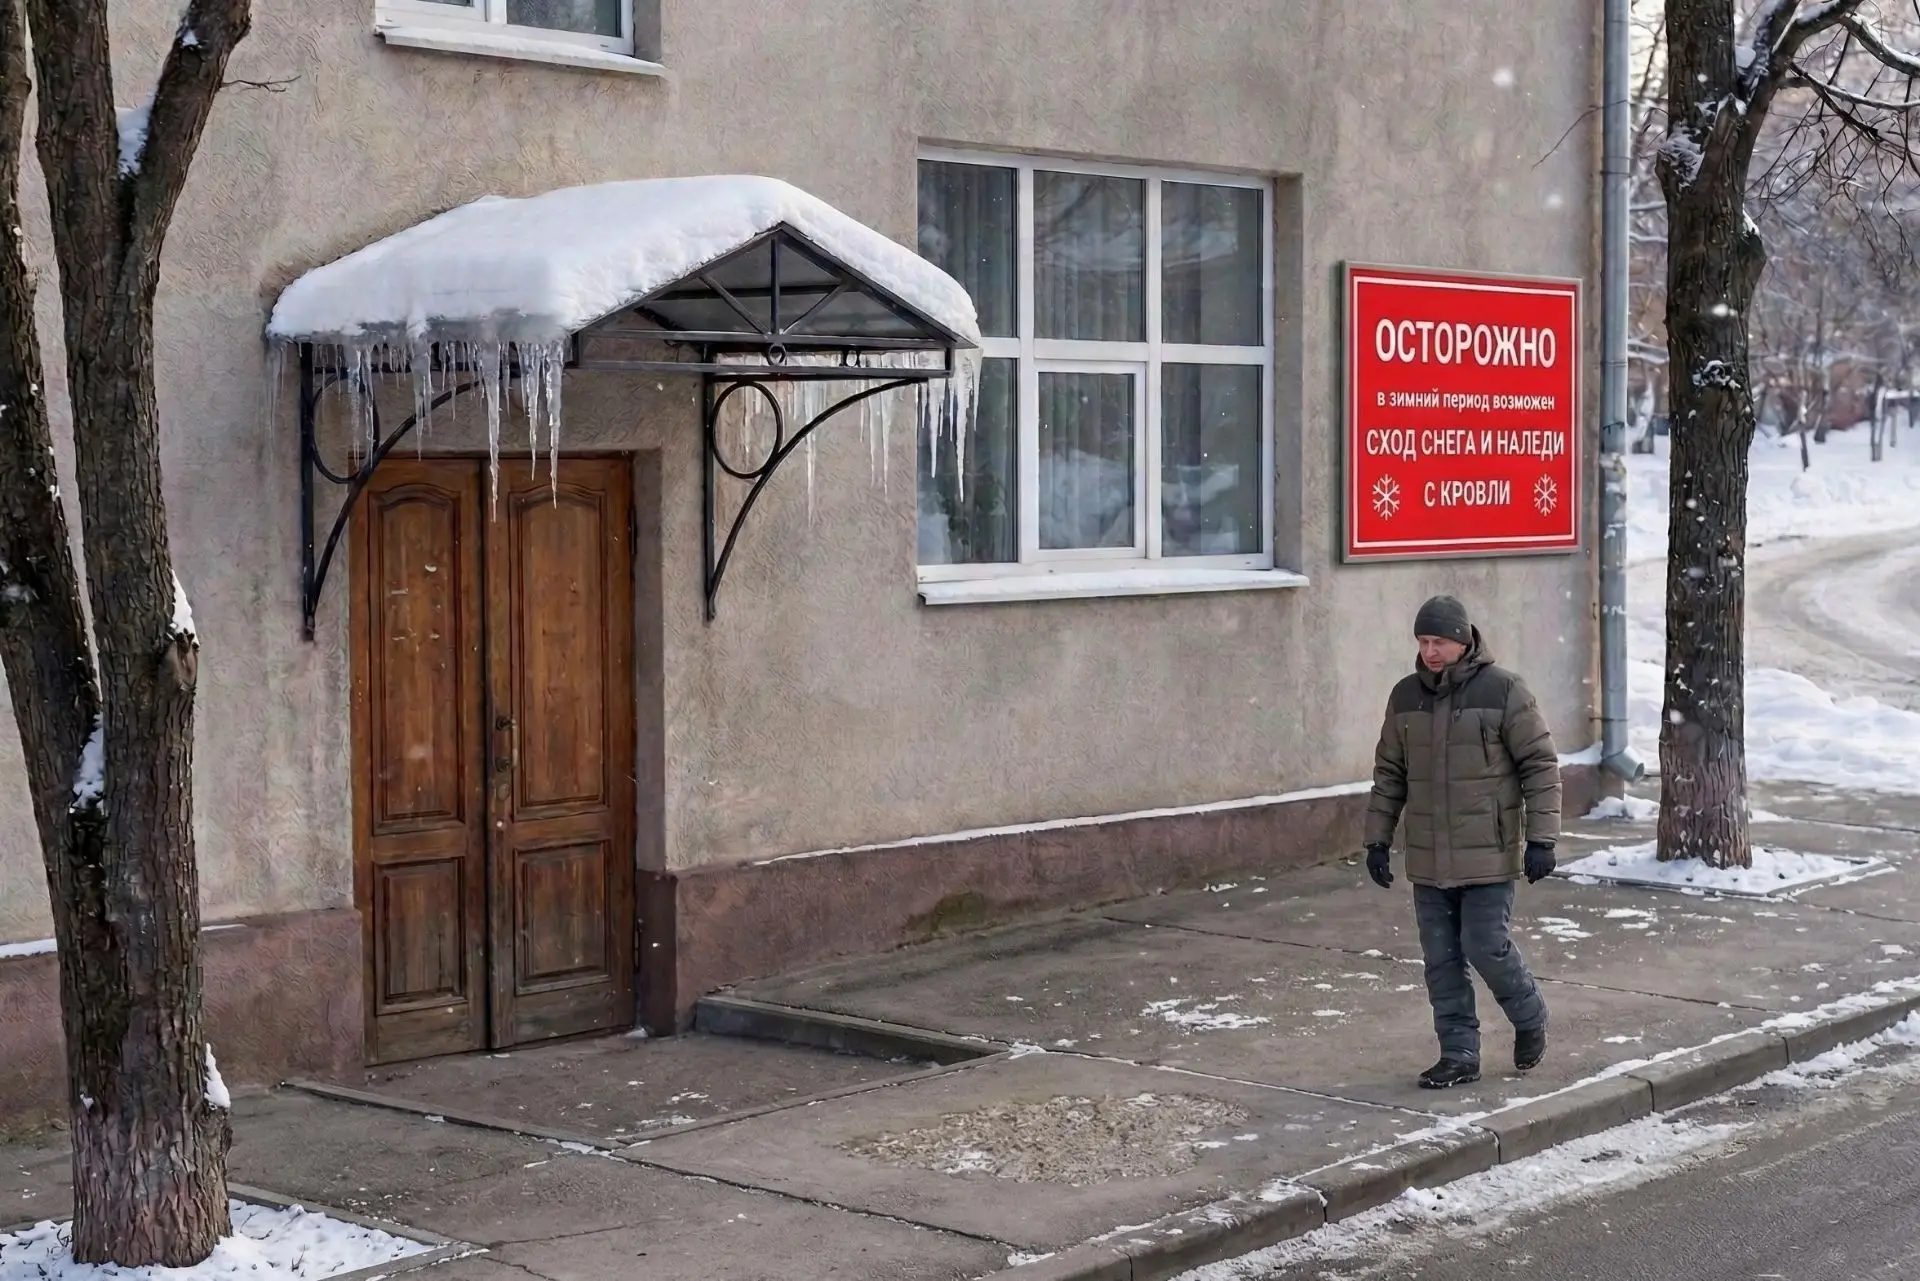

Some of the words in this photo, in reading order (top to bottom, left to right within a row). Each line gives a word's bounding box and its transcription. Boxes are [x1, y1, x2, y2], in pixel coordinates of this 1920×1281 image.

[1375, 318, 1556, 368] ОСТОРОЖНО
[1389, 388, 1440, 408] зимний
[1443, 393, 1490, 413] период
[1493, 394, 1555, 411] возможен
[1366, 428, 1417, 462] СХОД
[1421, 429, 1477, 456] СНЕГА
[1480, 430, 1493, 455] И
[1497, 430, 1564, 461] НАЛЕДИ
[1440, 479, 1510, 507] КРОВЛИ
